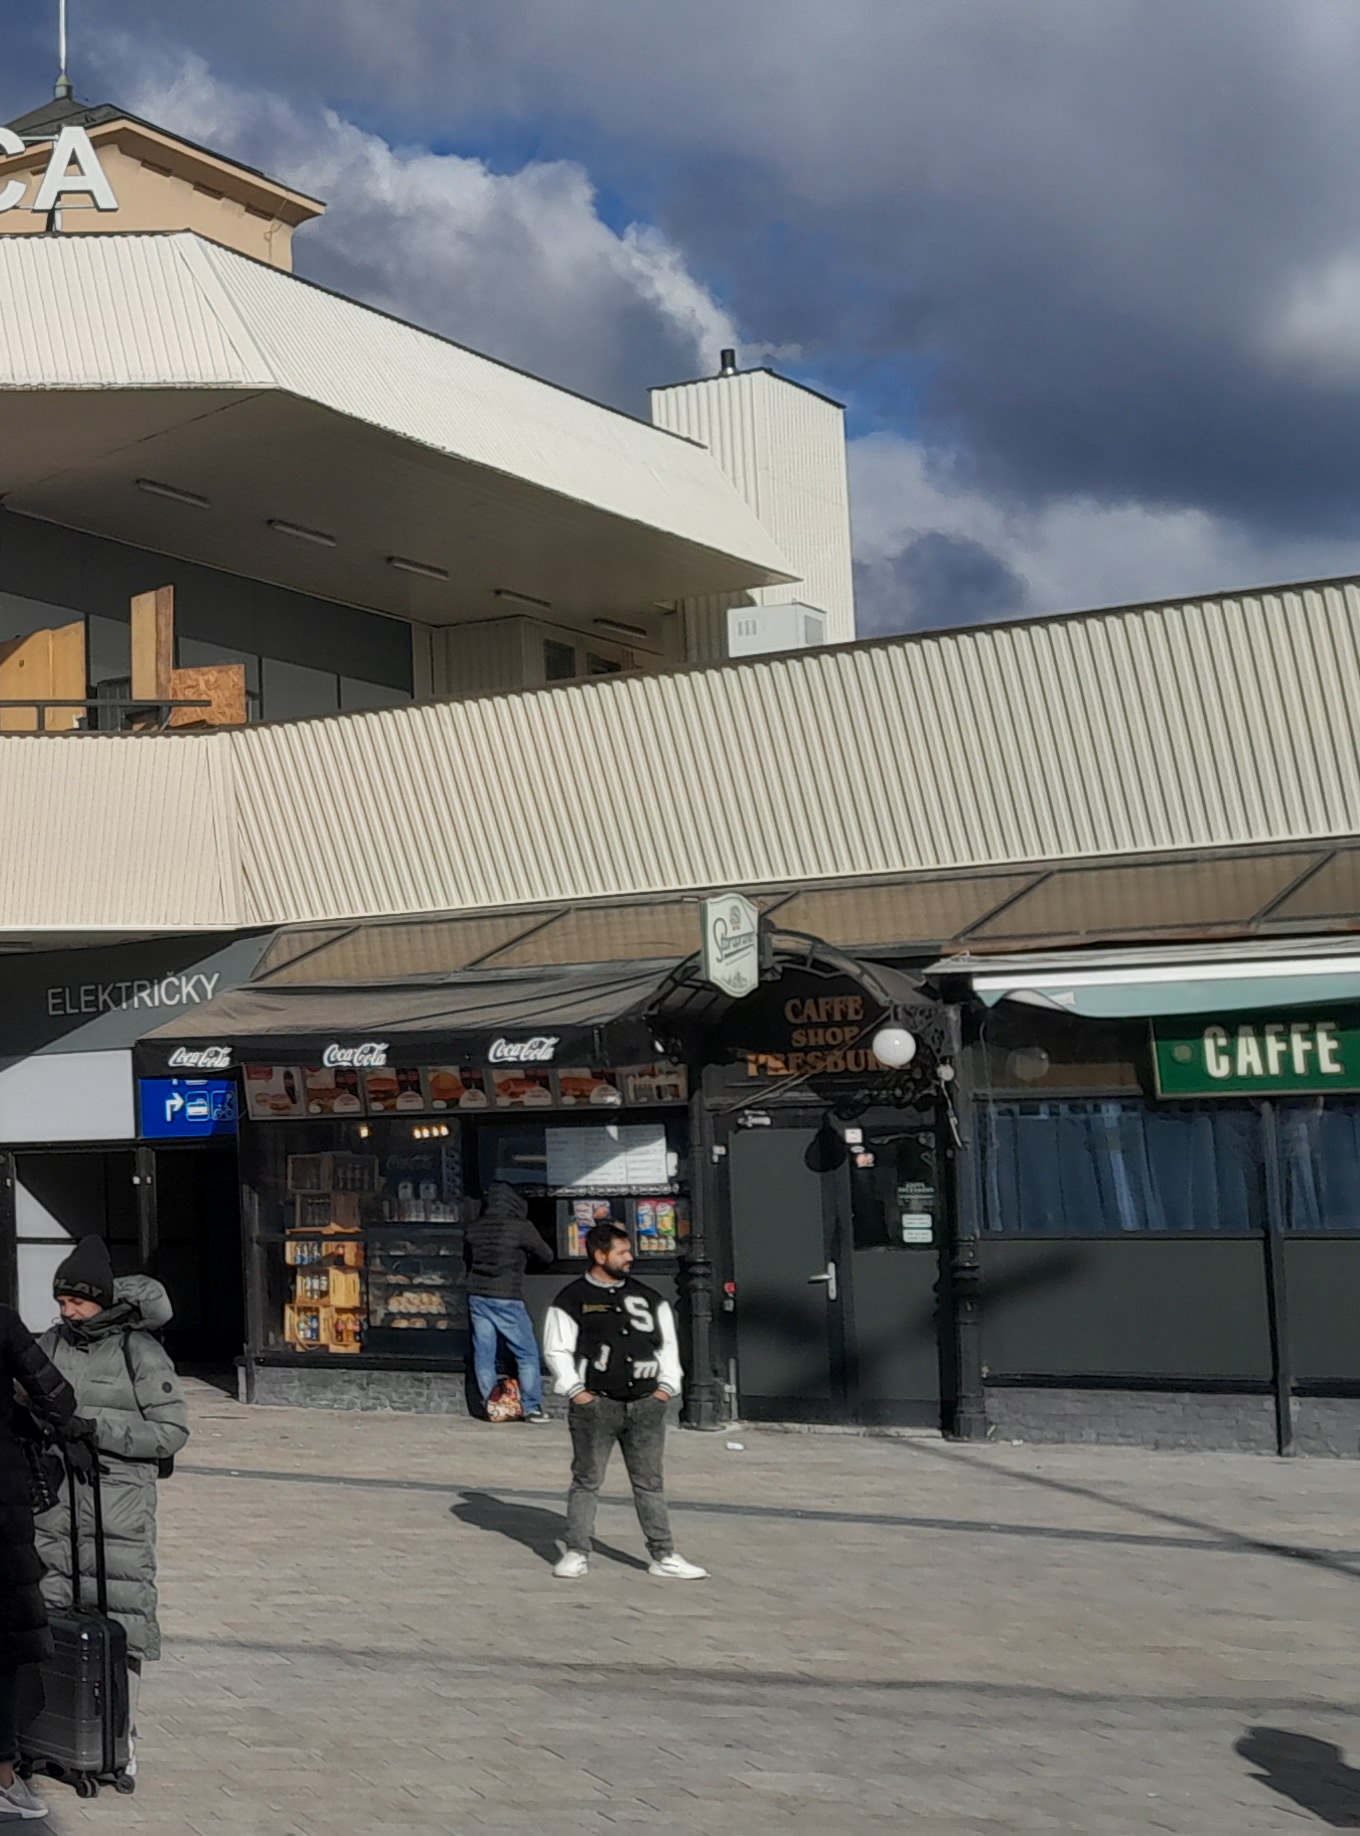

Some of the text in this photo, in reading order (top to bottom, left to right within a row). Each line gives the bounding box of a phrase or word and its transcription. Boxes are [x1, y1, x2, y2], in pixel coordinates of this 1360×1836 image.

[47, 970, 220, 1016] ELEKTRIČKY
[784, 996, 864, 1024] CAFFE
[791, 1025, 861, 1048] SHOP
[1202, 1021, 1344, 1079] CAFFE
[624, 1295, 655, 1333] S
